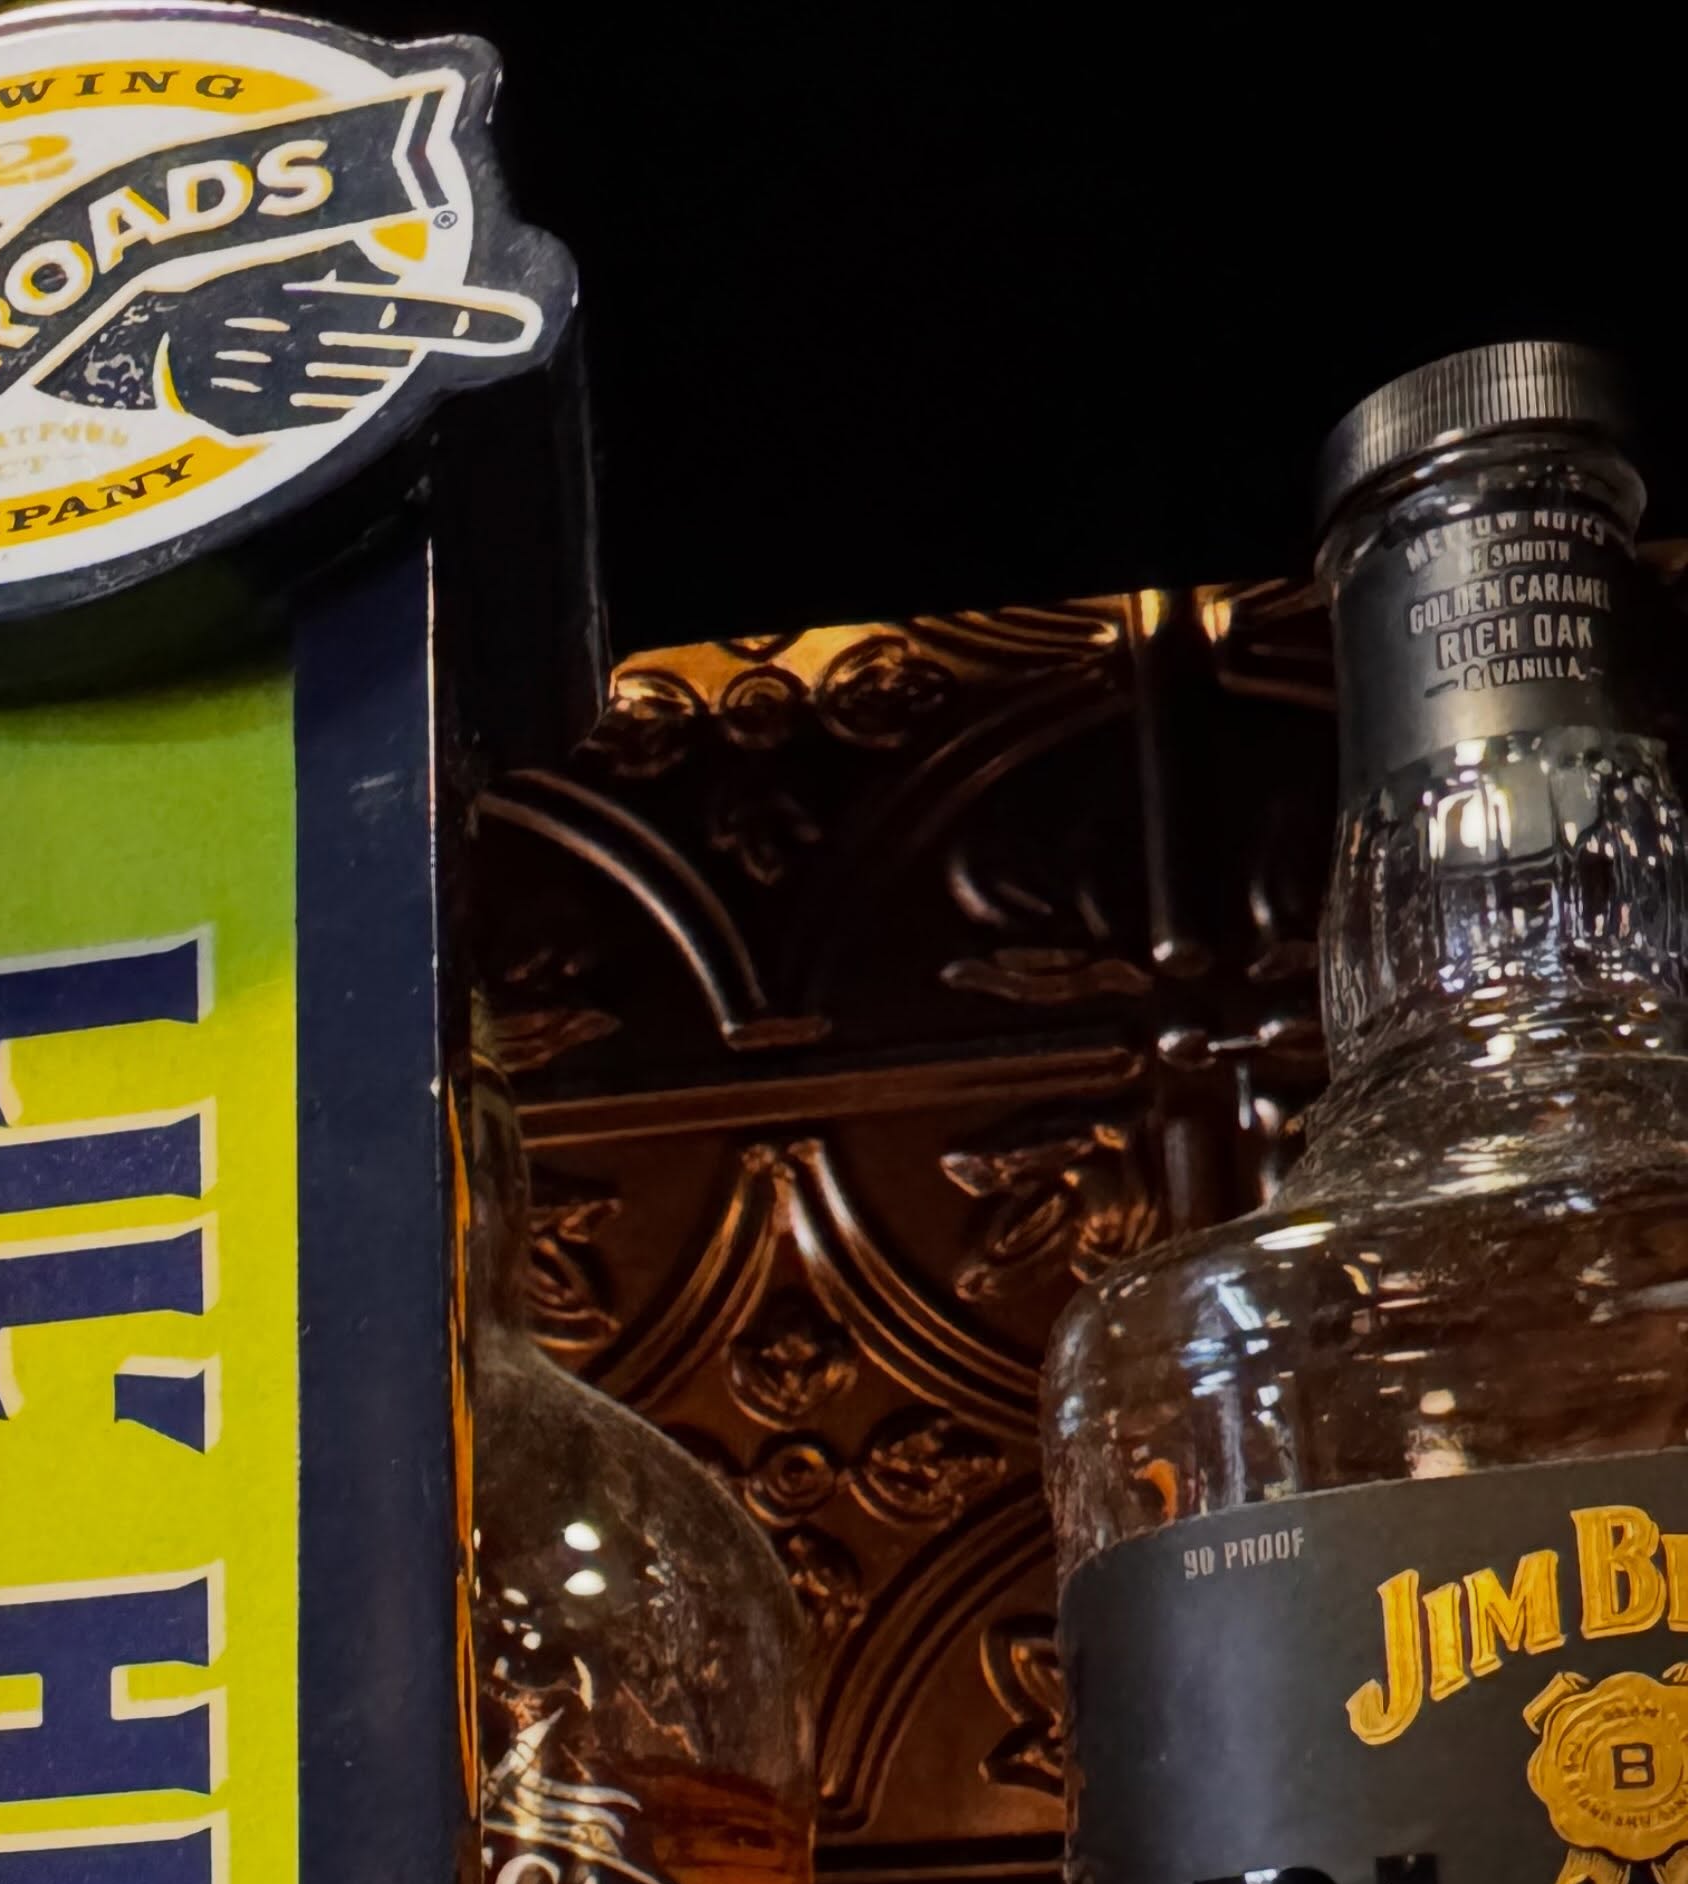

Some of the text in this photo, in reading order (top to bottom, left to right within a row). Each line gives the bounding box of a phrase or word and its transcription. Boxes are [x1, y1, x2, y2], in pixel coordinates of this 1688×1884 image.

[1410, 572, 1611, 634] GOLDEN CARAMEL
[1438, 613, 1594, 669] RICH OAK
[1489, 656, 1586, 685] VANILLA
[1183, 1527, 1305, 1581] 90 PROOF
[1345, 1549, 1566, 1747] JIM
[1611, 1742, 1656, 1790] B
